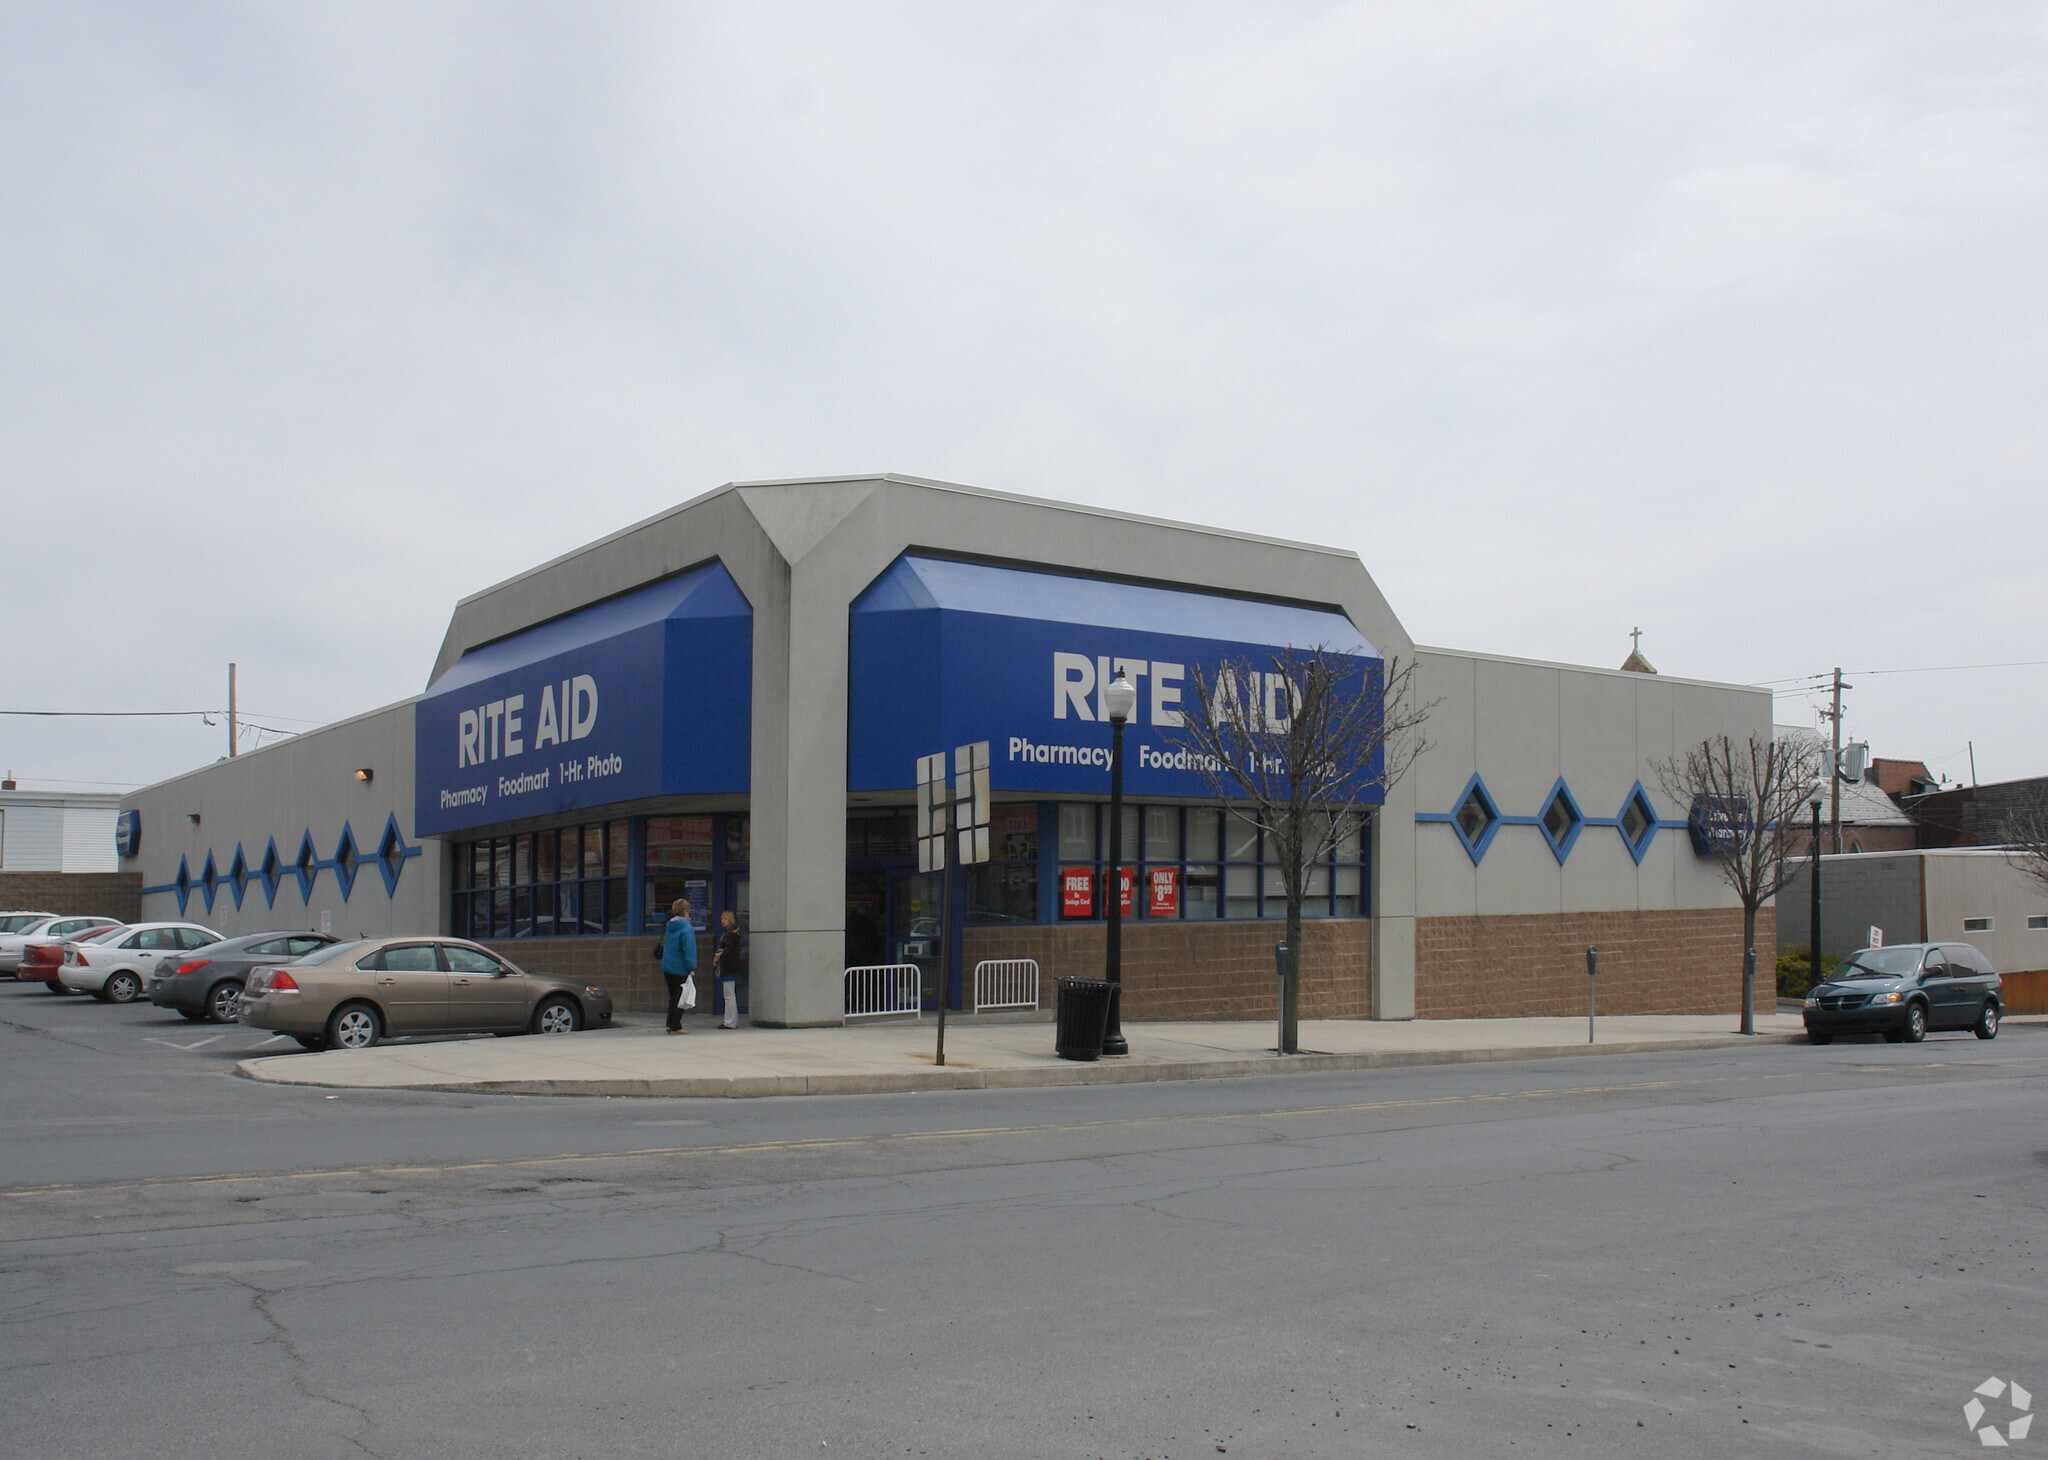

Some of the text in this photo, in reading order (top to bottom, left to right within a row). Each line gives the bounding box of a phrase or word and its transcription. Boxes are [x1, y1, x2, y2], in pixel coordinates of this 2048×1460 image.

[1053, 651, 1303, 734] RITE AID
[459, 674, 598, 769] RITE AID
[1009, 737, 1113, 771] Pharmacy
[1140, 745, 1230, 772] Foodmart
[440, 752, 622, 809] Pharmacy Foodmart 1-Hr. Photo
[1066, 877, 1089, 891] FREE
[1154, 872, 1174, 884] ONLY
